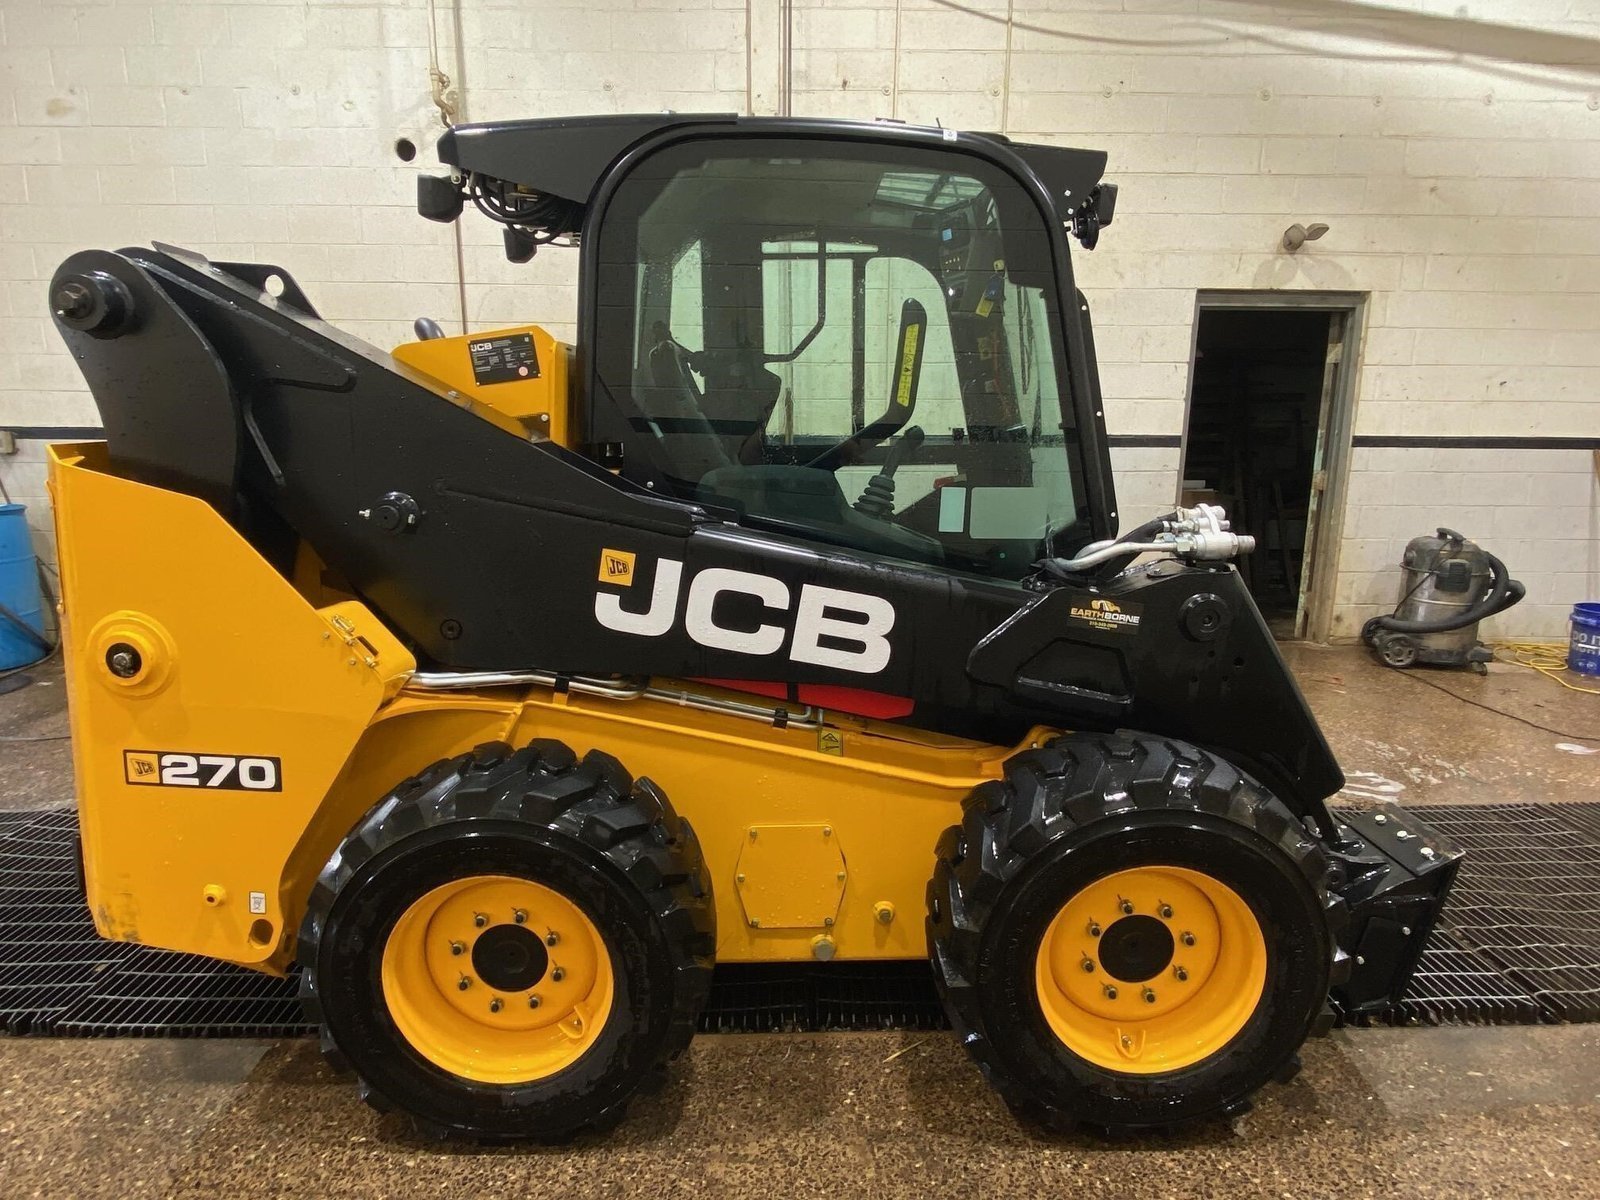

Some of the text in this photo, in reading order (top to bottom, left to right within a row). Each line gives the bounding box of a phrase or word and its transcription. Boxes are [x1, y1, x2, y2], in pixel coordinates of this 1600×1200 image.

[470, 342, 493, 352] JCB
[609, 558, 628, 575] JCB
[595, 557, 896, 674] JCB
[1070, 607, 1140, 624] EARTHBORNE
[136, 760, 154, 775] JCB
[161, 754, 276, 789] 270
